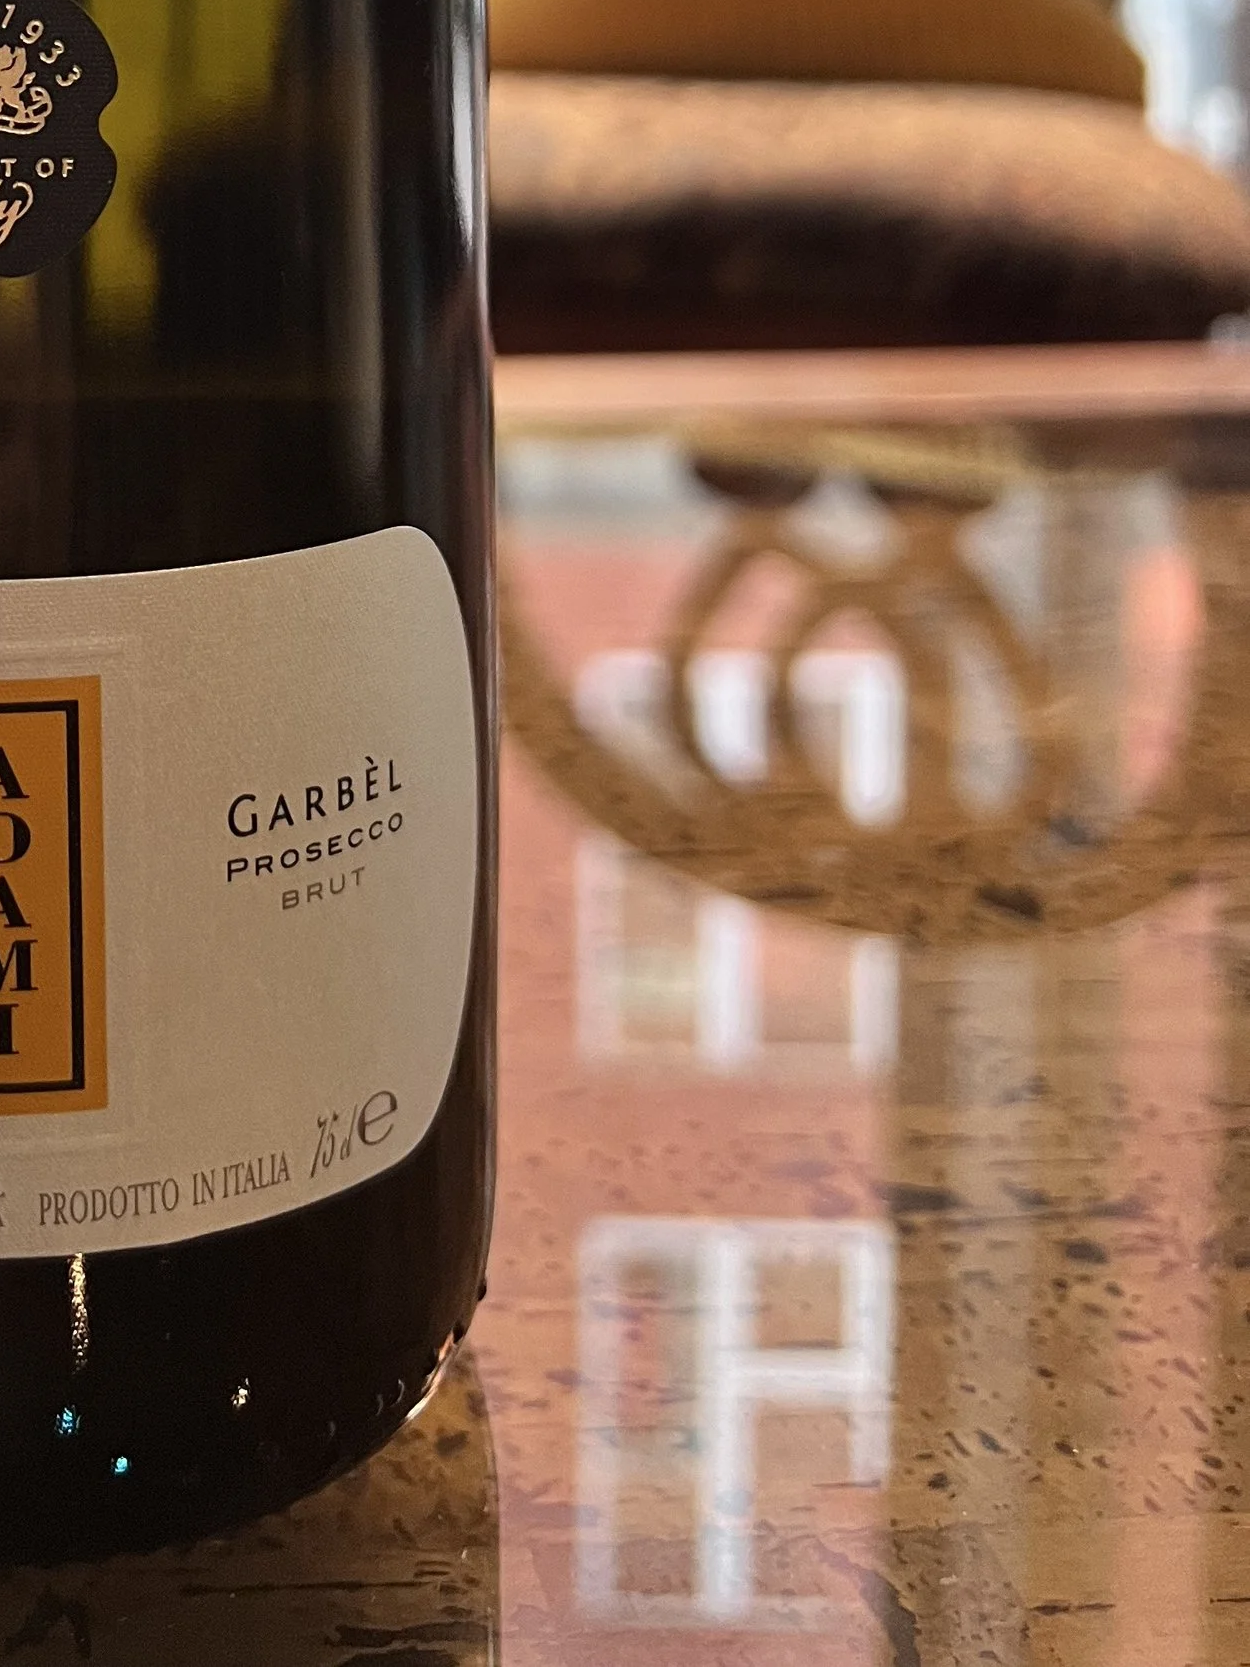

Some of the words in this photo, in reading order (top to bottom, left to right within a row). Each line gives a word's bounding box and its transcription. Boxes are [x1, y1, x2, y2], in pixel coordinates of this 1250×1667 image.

[0, 3, 82, 87] 1933
[35, 157, 74, 177] OF
[227, 755, 402, 837] GARBÈL
[226, 812, 403, 882] PROSECCO
[281, 866, 366, 910] BRUT
[39, 1177, 180, 1227] PRODOTTO
[192, 1171, 216, 1206] IN
[222, 1150, 291, 1200] ITALIA
